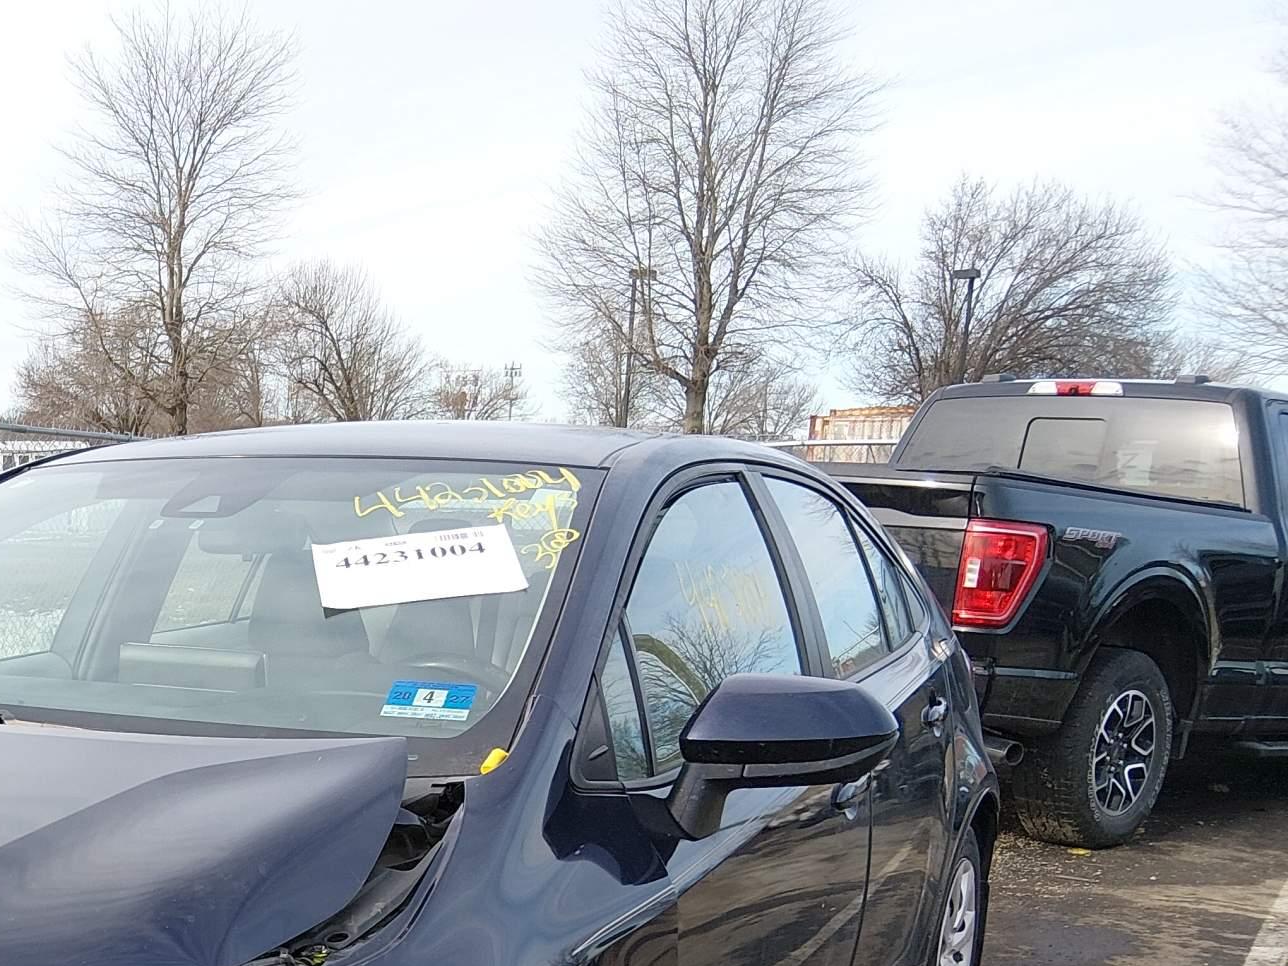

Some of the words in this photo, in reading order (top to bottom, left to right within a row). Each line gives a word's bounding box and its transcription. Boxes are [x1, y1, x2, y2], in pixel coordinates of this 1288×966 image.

[1063, 526, 1122, 541] SPORT
[335, 541, 486, 569] 44231004
[423, 690, 435, 704] 4
